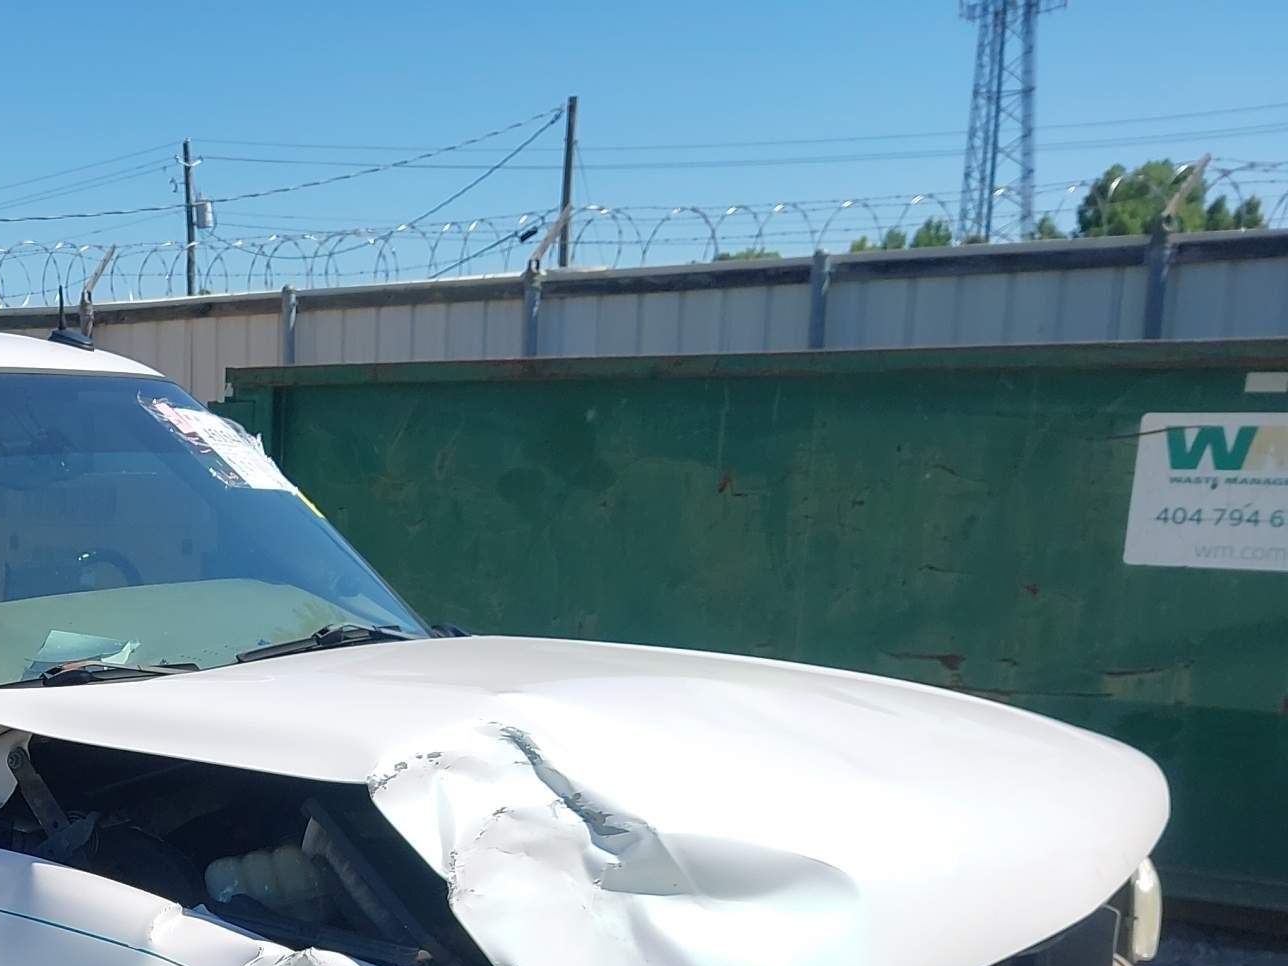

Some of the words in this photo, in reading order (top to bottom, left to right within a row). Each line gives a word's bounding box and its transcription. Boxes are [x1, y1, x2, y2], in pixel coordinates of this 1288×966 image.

[1156, 507, 1203, 524] 404
[1213, 507, 1259, 526] 794
[1269, 509, 1285, 527] 6
